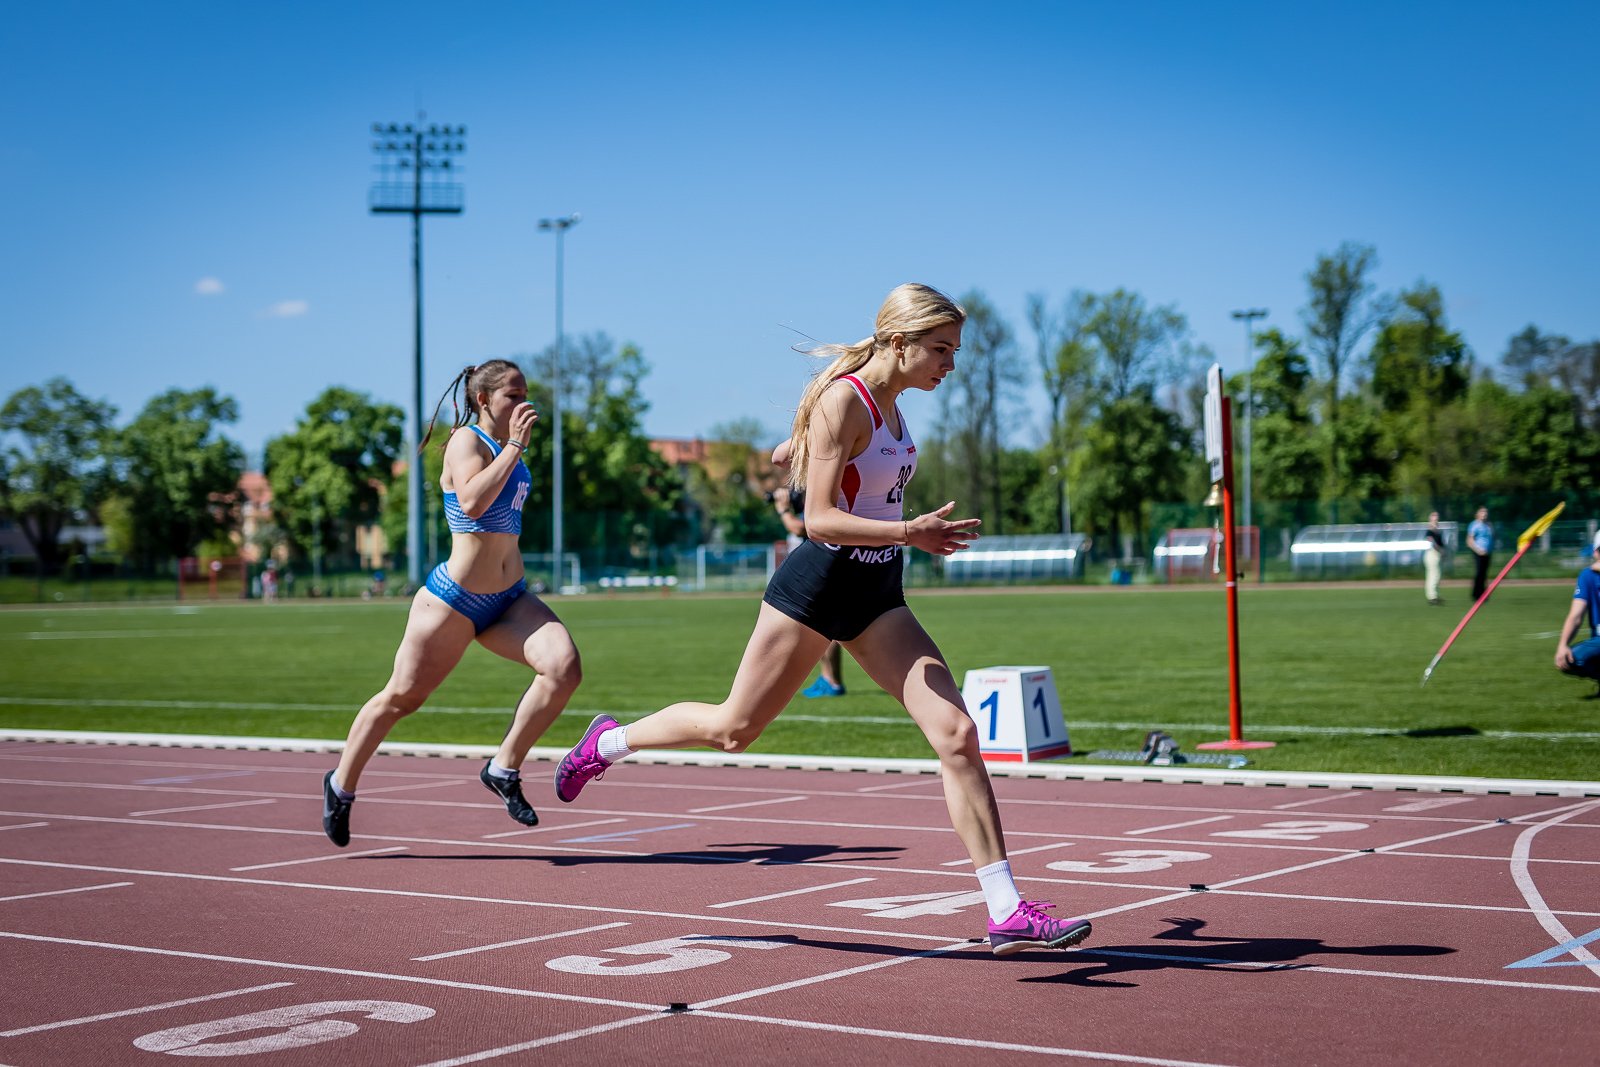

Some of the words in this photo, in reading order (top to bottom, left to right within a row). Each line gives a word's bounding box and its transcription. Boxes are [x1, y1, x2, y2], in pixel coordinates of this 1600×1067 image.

[849, 547, 893, 564] NIKE
[980, 691, 998, 741] 1
[1033, 687, 1051, 738] 1
[1208, 820, 1369, 840] 2
[1046, 850, 1211, 873] 3
[824, 890, 1025, 919] 4
[545, 934, 792, 976] 5
[133, 1000, 436, 1057] 6
